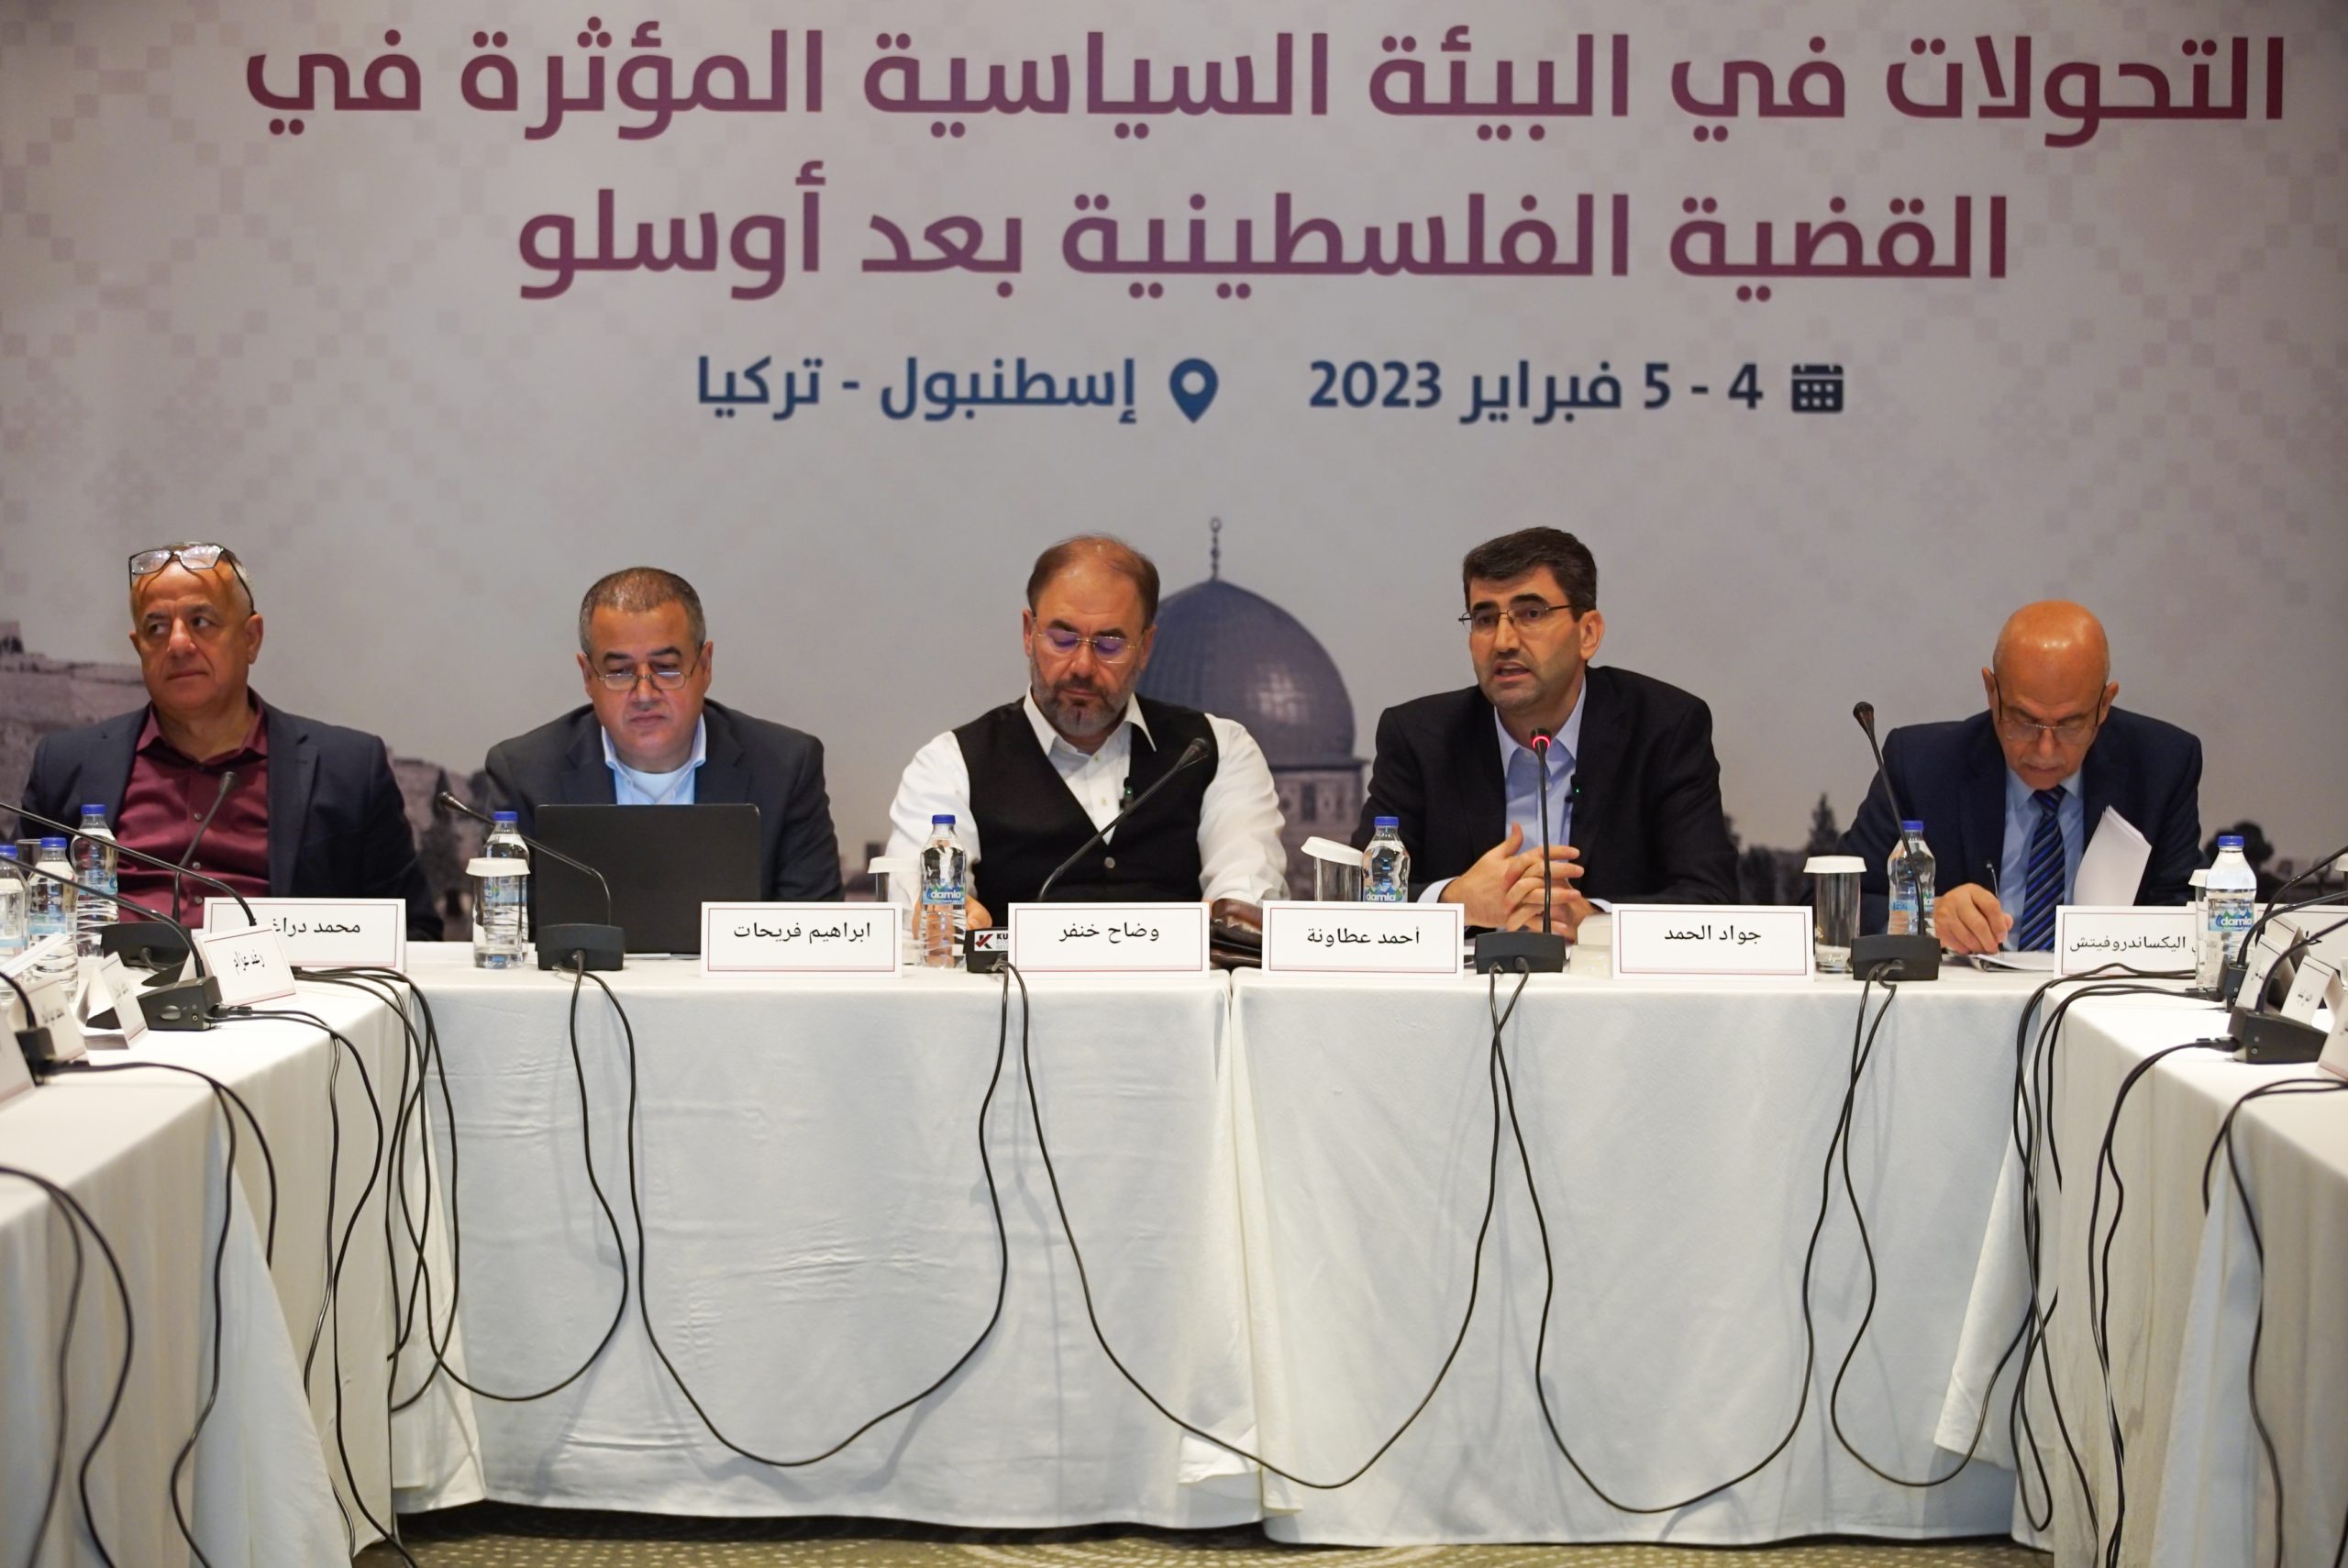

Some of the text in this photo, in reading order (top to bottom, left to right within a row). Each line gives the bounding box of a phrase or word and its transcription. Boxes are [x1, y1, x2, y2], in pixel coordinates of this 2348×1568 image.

[246, 16, 2285, 148] التحولات في البيئة السياسية المؤثرة في
[518, 160, 2008, 303] القضية الفلسطينية بعد أوسلو
[698, 355, 824, 422] تركيا
[880, 356, 1137, 425] إسطنبول
[1309, 359, 1443, 409] 2023
[1458, 359, 1623, 425] فبراير
[1644, 362, 1671, 410] 5
[1727, 362, 1764, 410] 4
[1366, 891, 1396, 901] damla
[272, 917, 360, 937] محمد دراغ
[734, 922, 870, 944] ابراهيم فريحات
[1058, 922, 1159, 944] وضاح خنفر
[1307, 926, 1420, 948] أحمد عطاونة
[1664, 924, 1762, 945] جواد الحمد
[2221, 916, 2252, 926] damla
[2069, 935, 2187, 953] اليكساندروفيتش
